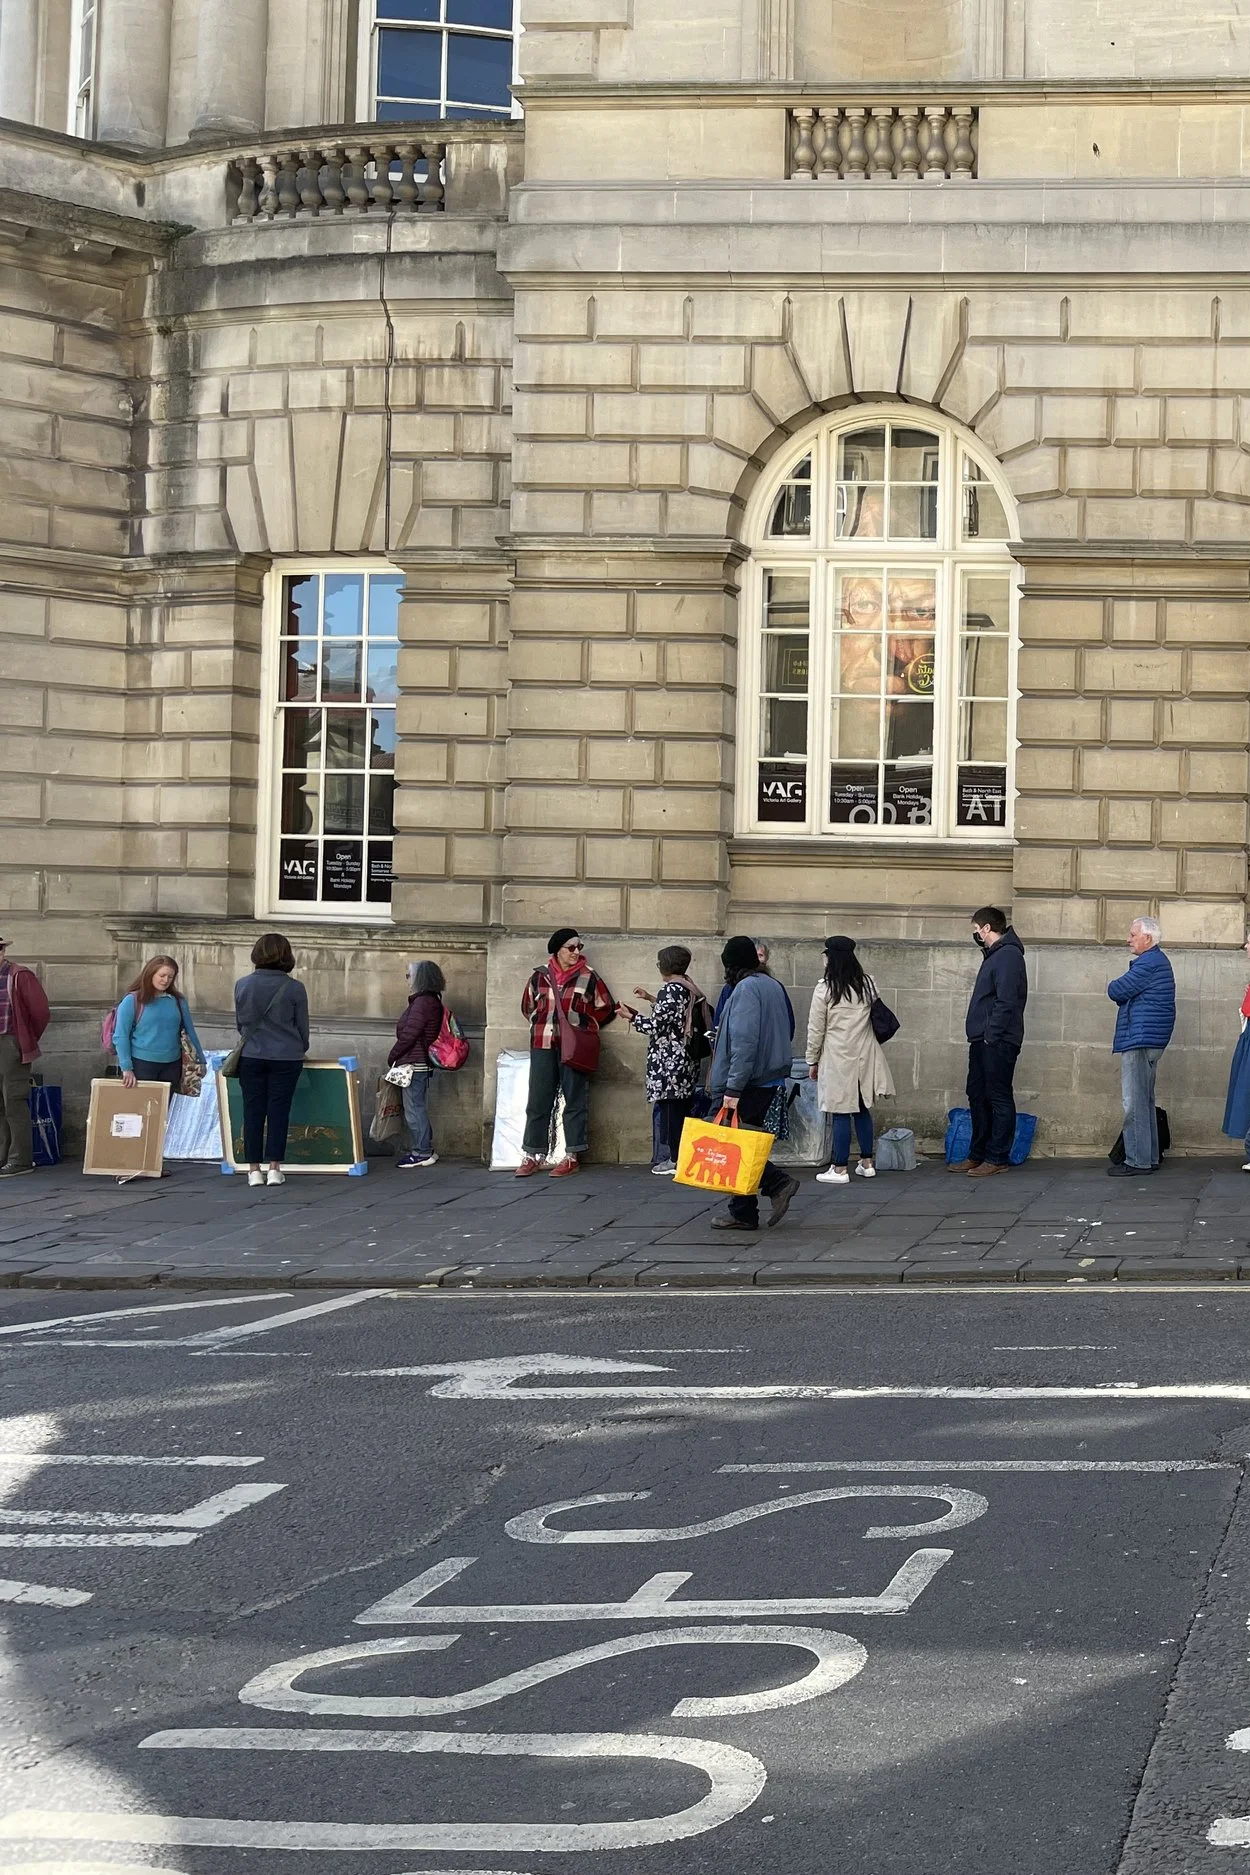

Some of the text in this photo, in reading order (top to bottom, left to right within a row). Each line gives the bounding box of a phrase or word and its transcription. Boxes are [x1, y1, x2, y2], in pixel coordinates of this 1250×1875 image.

[763, 781, 803, 798] VAG
[845, 784, 865, 792] Open
[899, 785, 918, 794] Open
[834, 791, 854, 799] Tuesday
[335, 853, 352, 861] Open
[284, 860, 316, 875] VAG
[0, 1485, 988, 1875] USES
